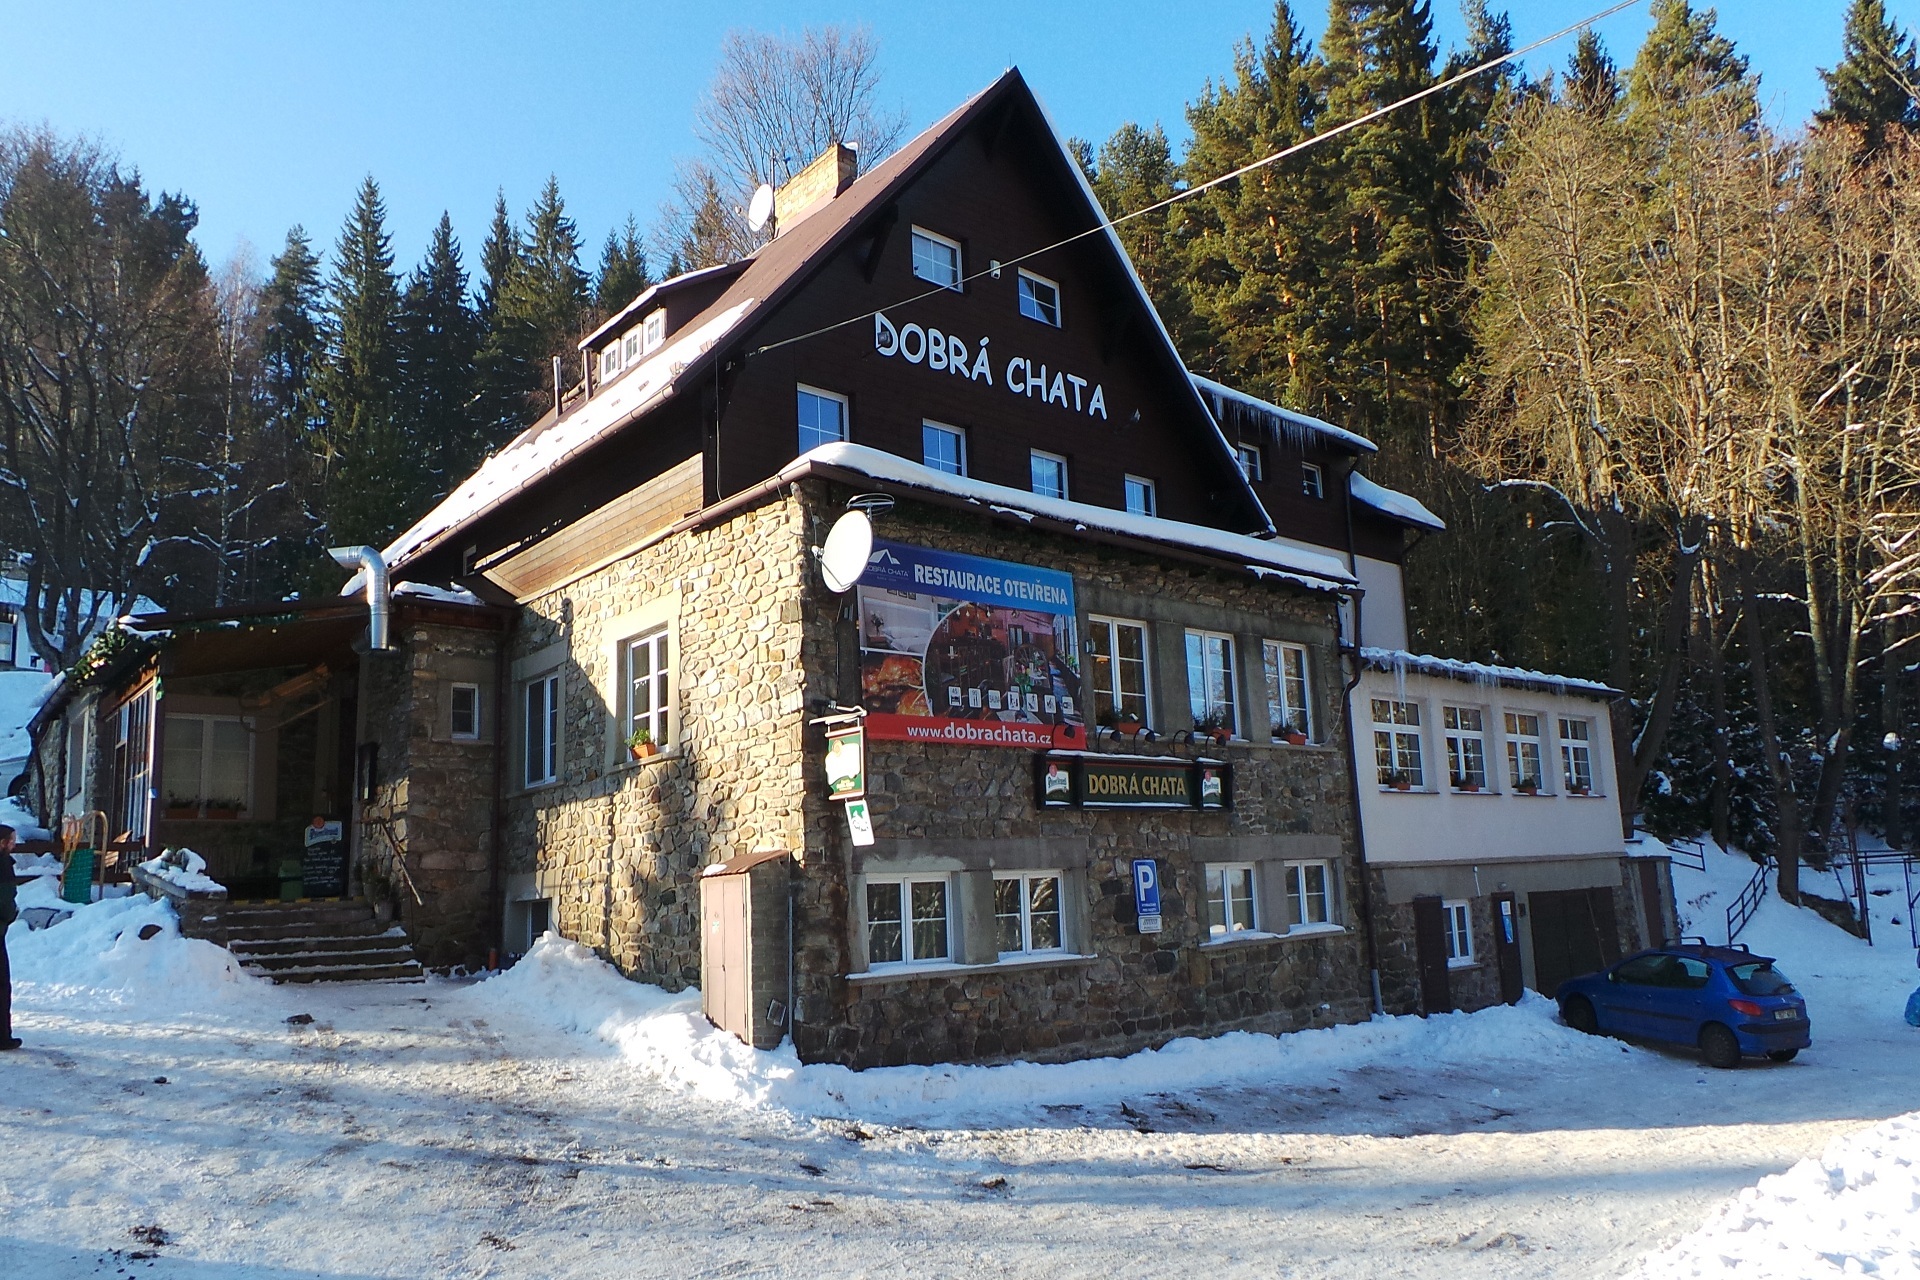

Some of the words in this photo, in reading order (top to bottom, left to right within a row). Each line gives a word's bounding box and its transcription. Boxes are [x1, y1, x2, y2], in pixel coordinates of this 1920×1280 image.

[875, 312, 993, 386] DOBRÁ
[1006, 356, 1107, 420] CHATA
[914, 563, 1001, 595] RESTAURACE
[1004, 579, 1068, 605] OTEVŘENA
[907, 722, 1051, 744] www.dobrachata.cz
[1088, 772, 1140, 795] DOBRÁ
[1141, 774, 1186, 796] CHATA
[1137, 864, 1154, 902] P
